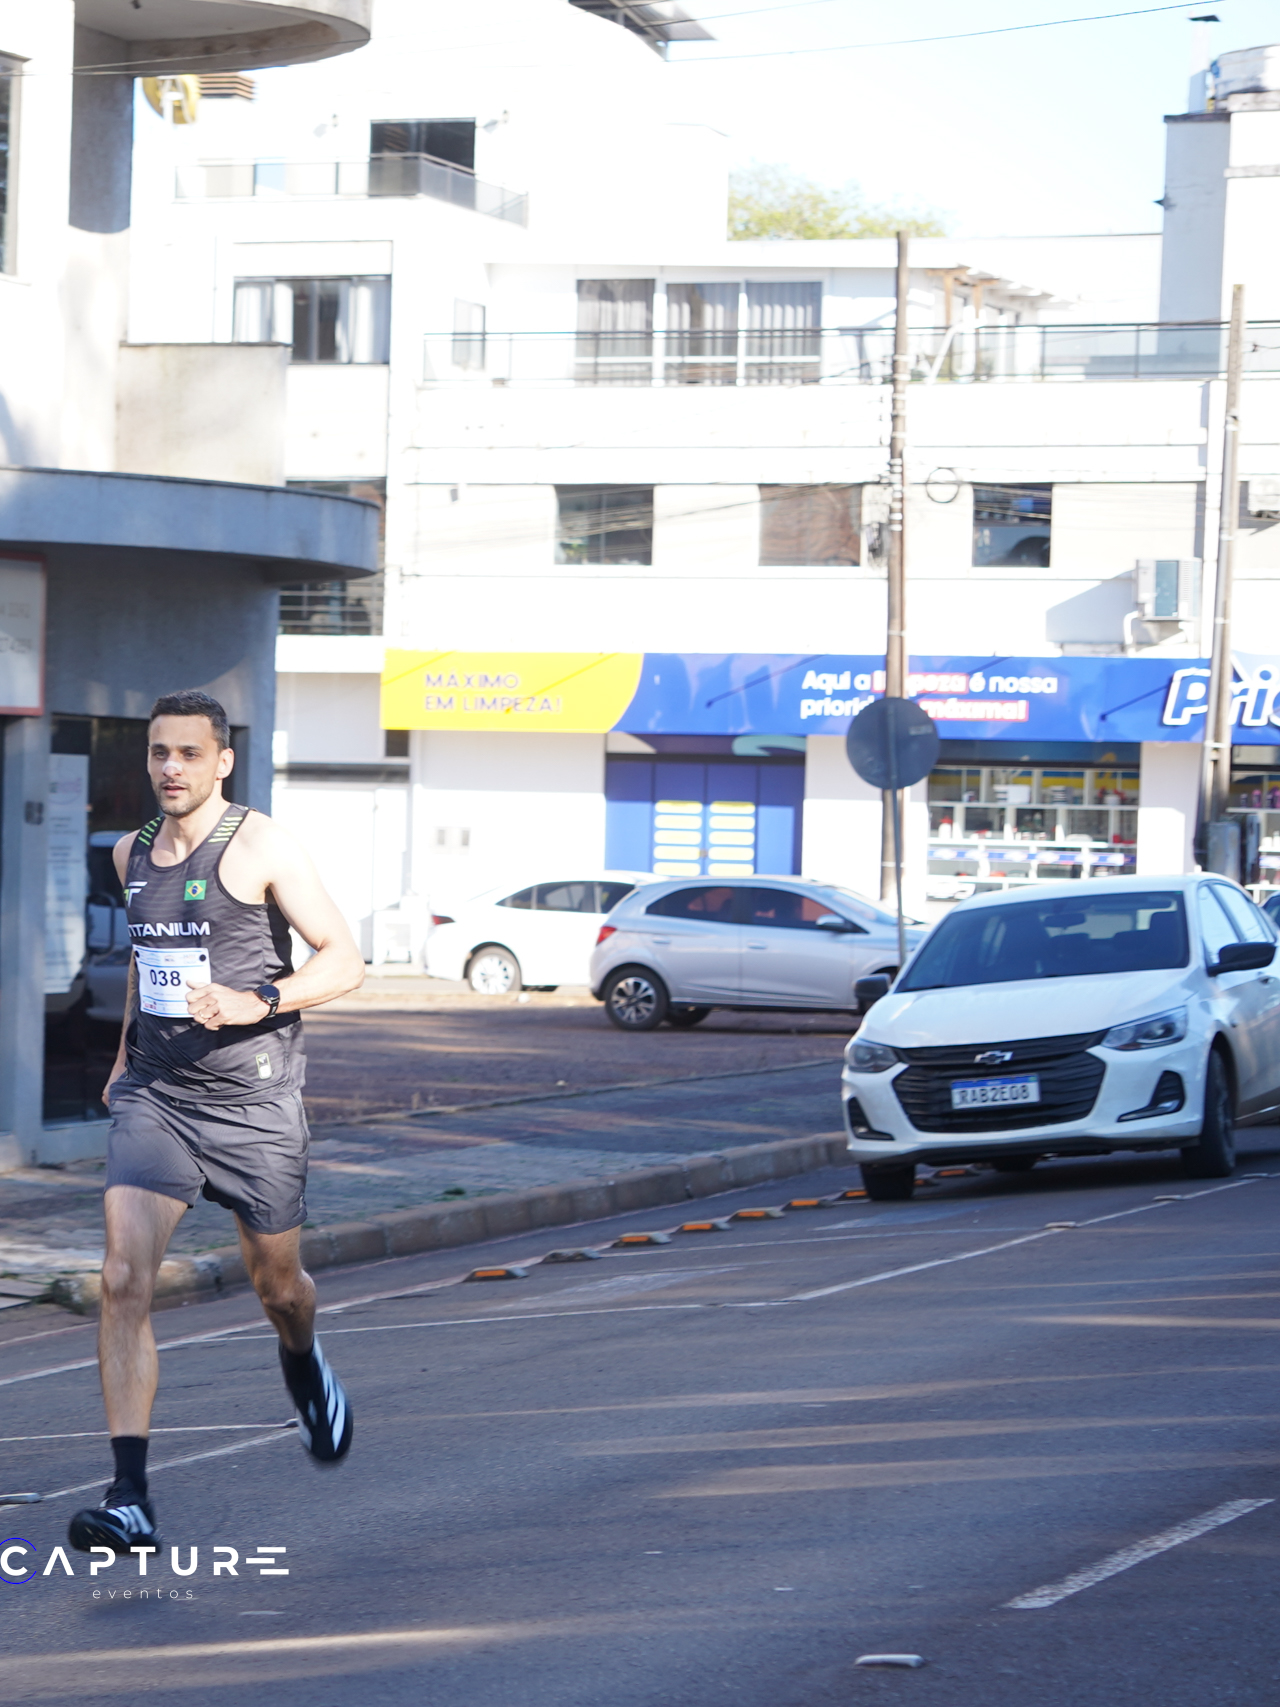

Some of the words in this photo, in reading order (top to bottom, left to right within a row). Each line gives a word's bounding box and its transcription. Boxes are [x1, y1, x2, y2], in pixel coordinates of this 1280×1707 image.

[801, 670, 851, 695] Aqui
[853, 674, 872, 691] a
[969, 671, 986, 692] é
[988, 676, 1058, 693] nossa
[424, 695, 454, 711] EM
[462, 696, 561, 712] LIMPEZA!
[1163, 664, 1280, 727] Pri
[150, 969, 181, 986] 038
